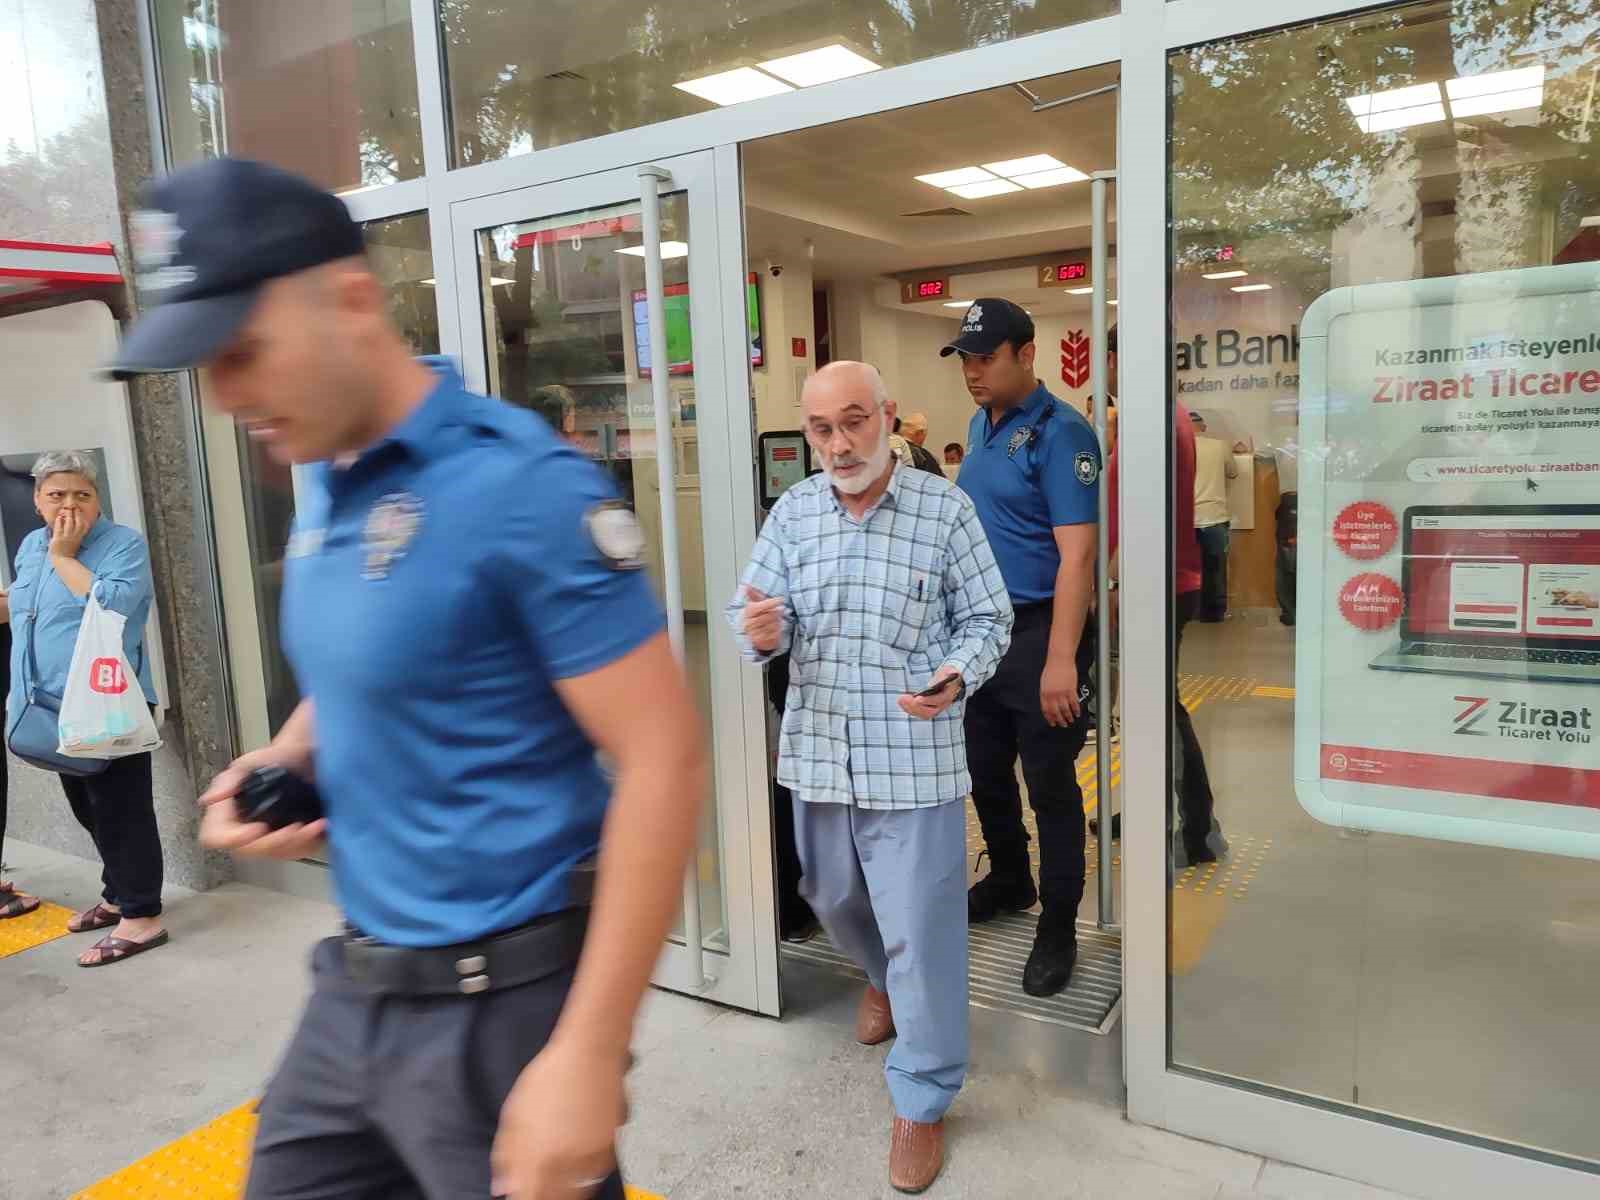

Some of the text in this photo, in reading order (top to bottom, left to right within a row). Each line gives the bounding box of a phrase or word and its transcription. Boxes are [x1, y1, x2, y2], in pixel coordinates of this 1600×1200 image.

[1042, 266, 1053, 282] 2
[1375, 341, 1494, 366] Kazanmak
[1230, 374, 1269, 390] daha
[1373, 373, 1474, 403] Ziraat
[1492, 409, 1528, 419] Ticaret
[1531, 407, 1554, 417] Yolu
[1557, 406, 1570, 416] ile
[1497, 701, 1591, 730] Ziraat
[1497, 725, 1591, 744] Ticaret Yolu
